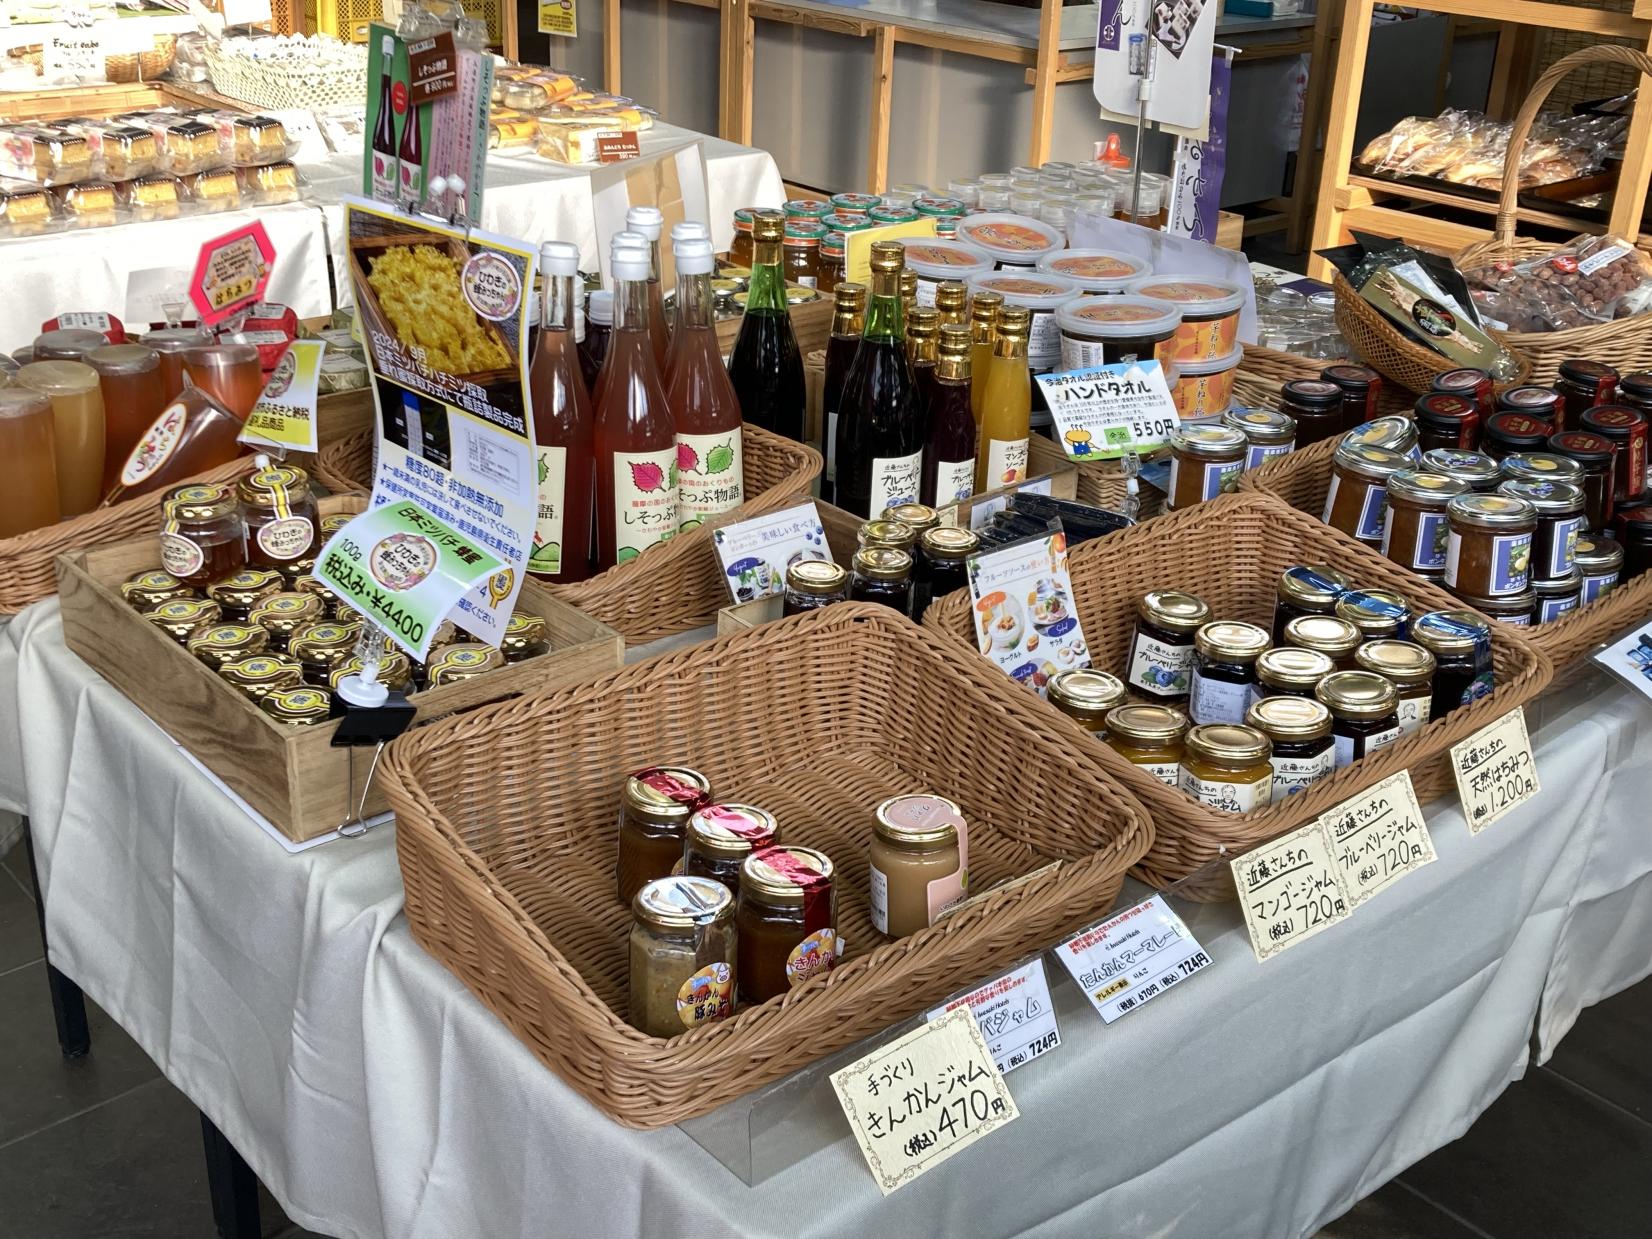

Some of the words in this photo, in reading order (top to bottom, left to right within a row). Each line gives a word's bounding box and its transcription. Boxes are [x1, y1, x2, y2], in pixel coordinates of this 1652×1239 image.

[1064, 380, 1152, 401] ハンドタオル
[1133, 418, 1176, 438] 550円
[1005, 460, 1025, 469] ソース
[886, 482, 917, 498] ジュース
[398, 506, 460, 549] 日本ミツバチ
[761, 519, 817, 543] 美味しい食べ方
[339, 538, 364, 562] 100g
[999, 651, 1023, 664] ヨーグルト
[1460, 738, 1504, 771] 近藤さんちの
[1469, 750, 1530, 798] 天然はちみつ
[1333, 798, 1390, 837] 近藤さんちの
[1338, 815, 1418, 871] ブルーベリージャム
[1376, 839, 1423, 877] 720円
[1246, 848, 1309, 887] 近藤さんちの
[1251, 869, 1336, 920] マンゴージャム
[1295, 894, 1346, 929] 720円
[1133, 967, 1149, 980] りんご
[1138, 983, 1160, 1002] 670円
[1178, 952, 1209, 975] 724円
[1028, 1031, 1059, 1057] 724円
[867, 1057, 915, 1096] 手づくり
[867, 1060, 991, 1139] きんかんジャム
[938, 1089, 1007, 1138] 470円
